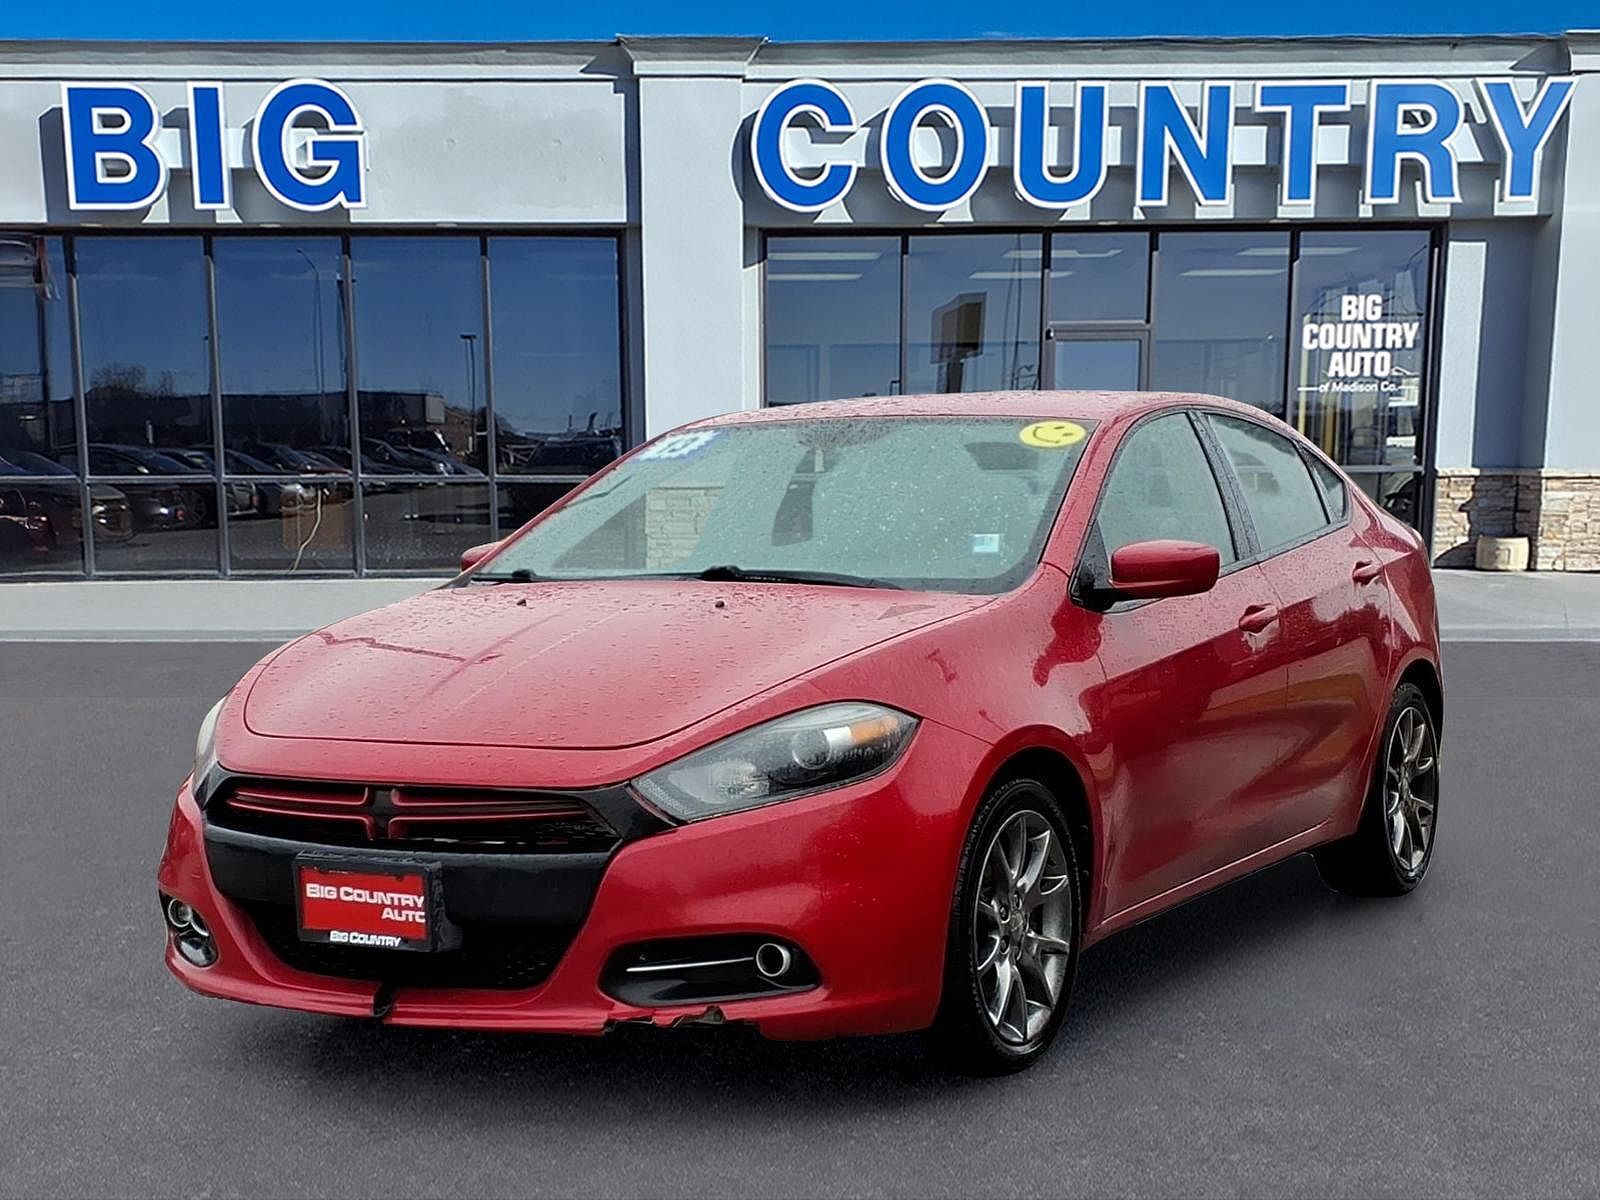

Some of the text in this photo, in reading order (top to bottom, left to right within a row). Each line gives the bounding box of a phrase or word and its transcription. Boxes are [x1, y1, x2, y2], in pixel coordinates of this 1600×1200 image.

[61, 76, 1578, 212] BIG COUNTRY
[1341, 294, 1383, 321] BIG
[1302, 322, 1420, 350] COUNTRY
[1328, 351, 1392, 377] AUTO
[1319, 381, 1330, 393] of
[1331, 381, 1378, 392] Madison
[306, 883, 425, 908] BIG COUNTRY
[329, 930, 402, 947] BIG COUNTRY
